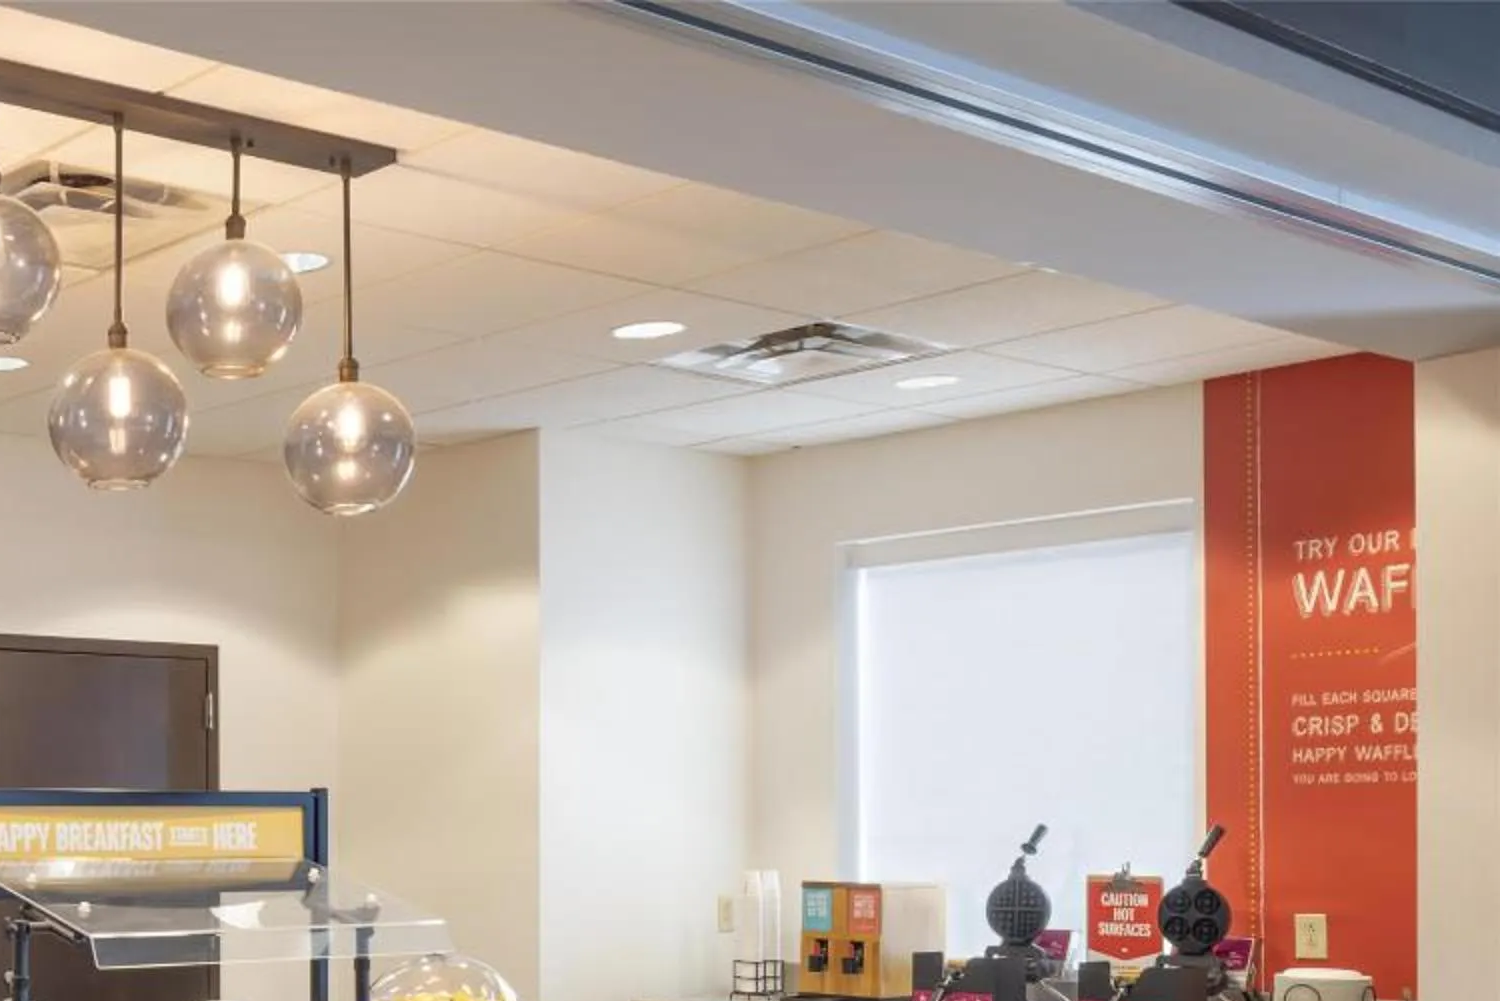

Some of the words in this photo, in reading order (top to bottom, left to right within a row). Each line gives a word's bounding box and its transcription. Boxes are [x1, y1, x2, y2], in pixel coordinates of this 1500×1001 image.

[1293, 535, 1338, 560] TRY
[1348, 530, 1399, 555] OUR
[1292, 563, 1416, 617] WAF
[1291, 693, 1316, 706] FILL
[1321, 691, 1358, 705] EACH
[1292, 714, 1359, 736] CRISP
[1370, 712, 1383, 734] &
[1292, 746, 1347, 763] HAPPY
[1318, 773, 1340, 785] ARE
[55, 821, 164, 851] BREAKFAST
[213, 821, 258, 850] HERE
[1101, 893, 1149, 907] CAUTION
[1113, 907, 1135, 921] HOT
[1097, 921, 1151, 937] SURFACES
